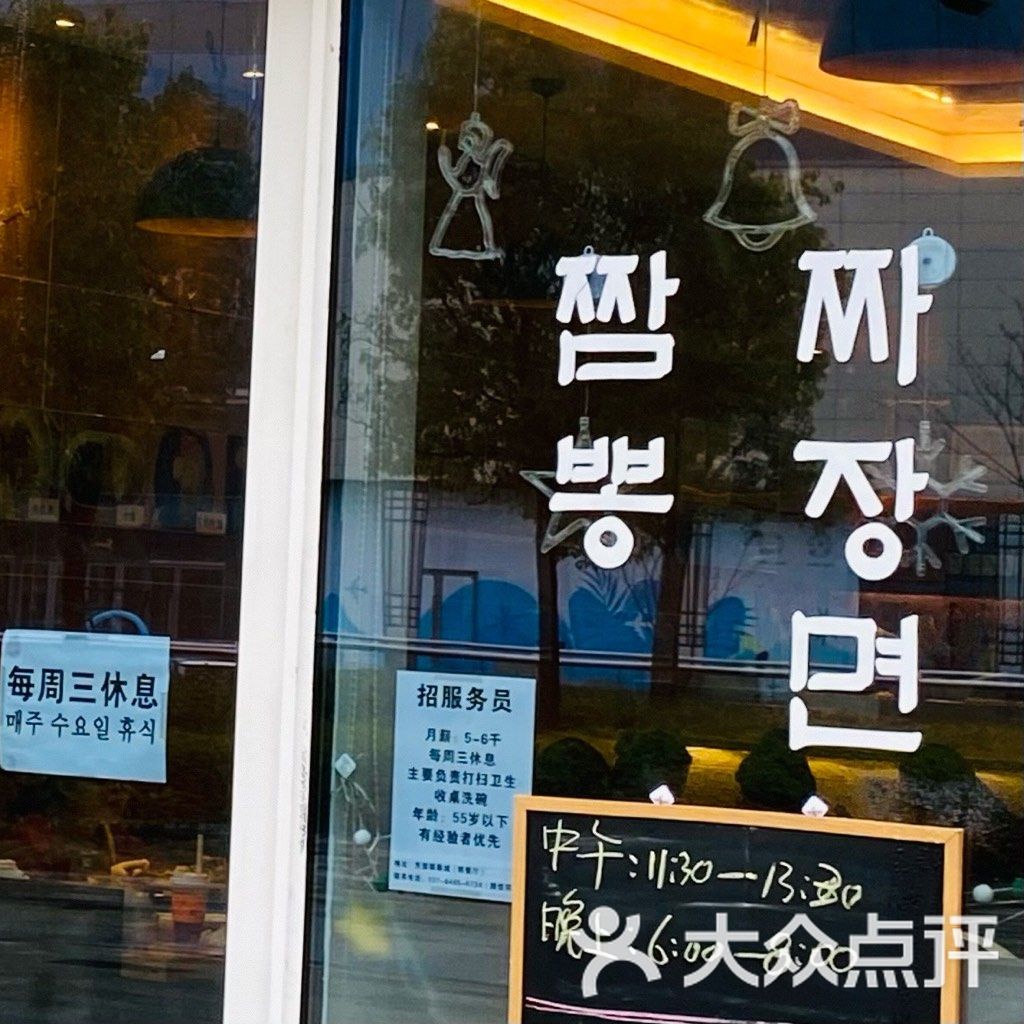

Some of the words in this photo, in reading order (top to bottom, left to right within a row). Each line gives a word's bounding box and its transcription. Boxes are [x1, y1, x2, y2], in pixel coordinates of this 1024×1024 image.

[548, 249, 681, 570] 짬뽕
[789, 244, 935, 753] 짜장면
[7, 665, 158, 710] 每周三休息
[417, 683, 512, 713] 招服务员
[6, 709, 44, 735] 매주
[51, 712, 110, 741] 수요일
[118, 716, 157, 745] 휴식
[429, 747, 496, 767] 每周三休息
[408, 767, 517, 790] 主要负责打扫卫生
[434, 789, 489, 808] 收桌洗碗
[419, 828, 501, 849] 有经验者优先
